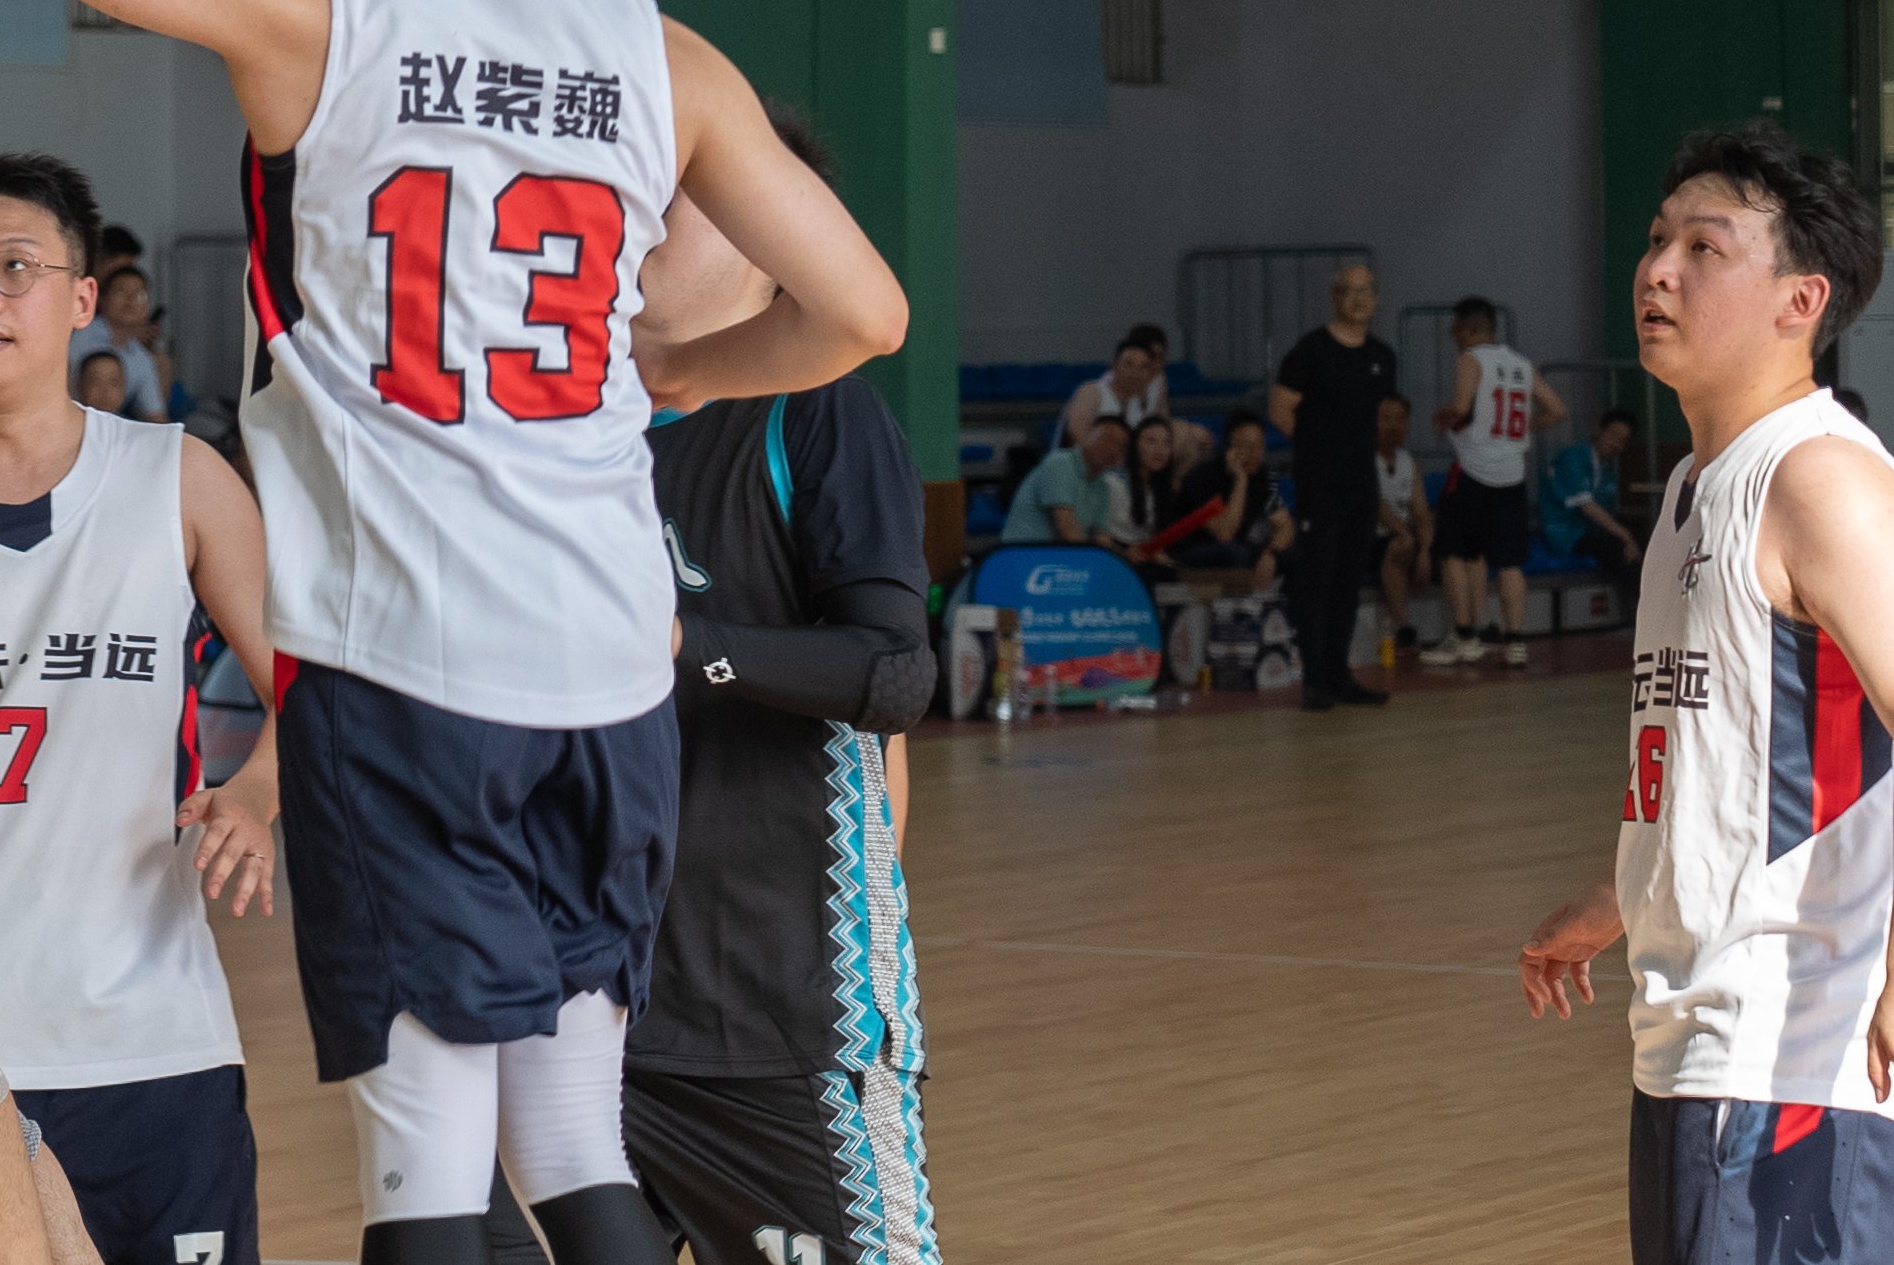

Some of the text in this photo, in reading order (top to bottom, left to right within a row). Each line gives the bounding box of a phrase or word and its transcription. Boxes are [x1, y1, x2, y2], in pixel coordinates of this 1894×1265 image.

[397, 51, 622, 143] 赵紫巍
[366, 165, 626, 425] 13
[1490, 386, 1527, 440] 16
